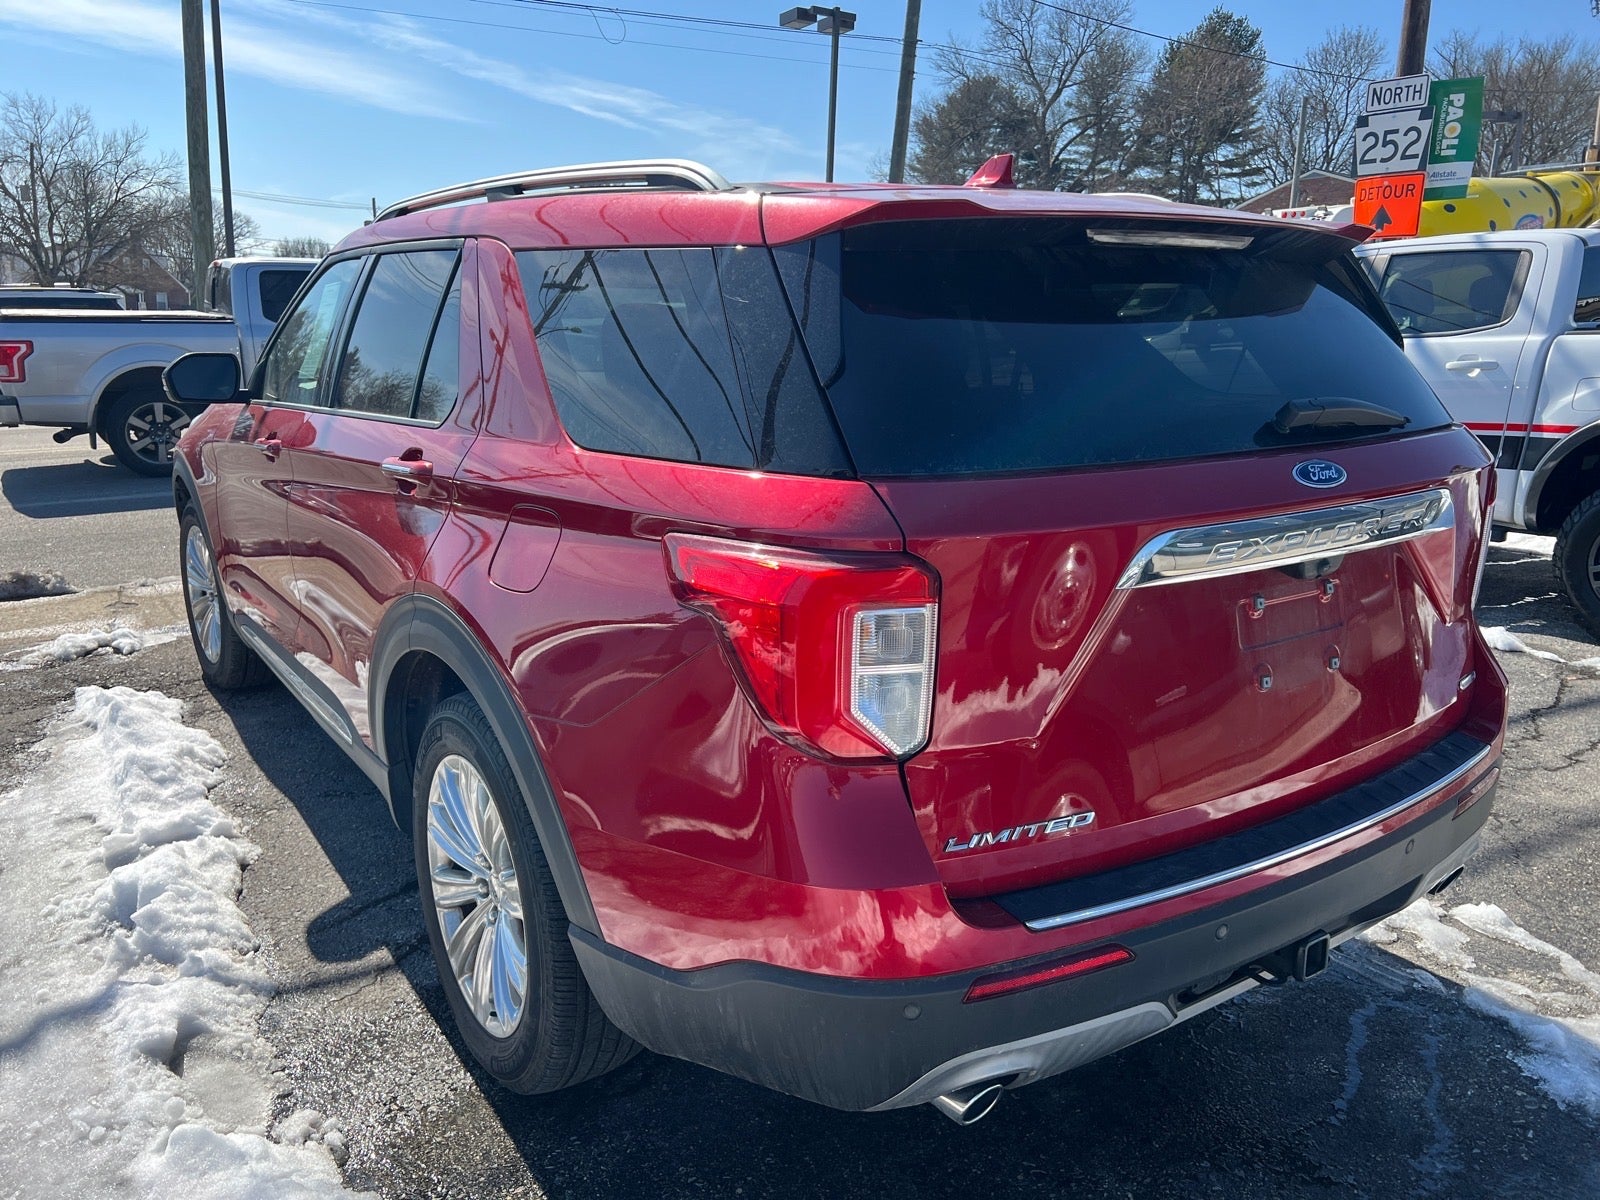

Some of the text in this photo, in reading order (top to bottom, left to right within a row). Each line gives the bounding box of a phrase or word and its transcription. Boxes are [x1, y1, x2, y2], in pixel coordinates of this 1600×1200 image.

[1370, 83, 1424, 107] NORTH
[1434, 97, 1449, 155] PAOLIBUSINESS.ORG
[1441, 93, 1465, 156] PAOLI
[1358, 126, 1423, 165] 252
[1359, 183, 1417, 203] DETOUR
[1430, 170, 1457, 179] Allstate
[1308, 463, 1339, 481] Ford
[1205, 507, 1428, 565] EXPLORER
[943, 811, 1096, 852] LIMITED
